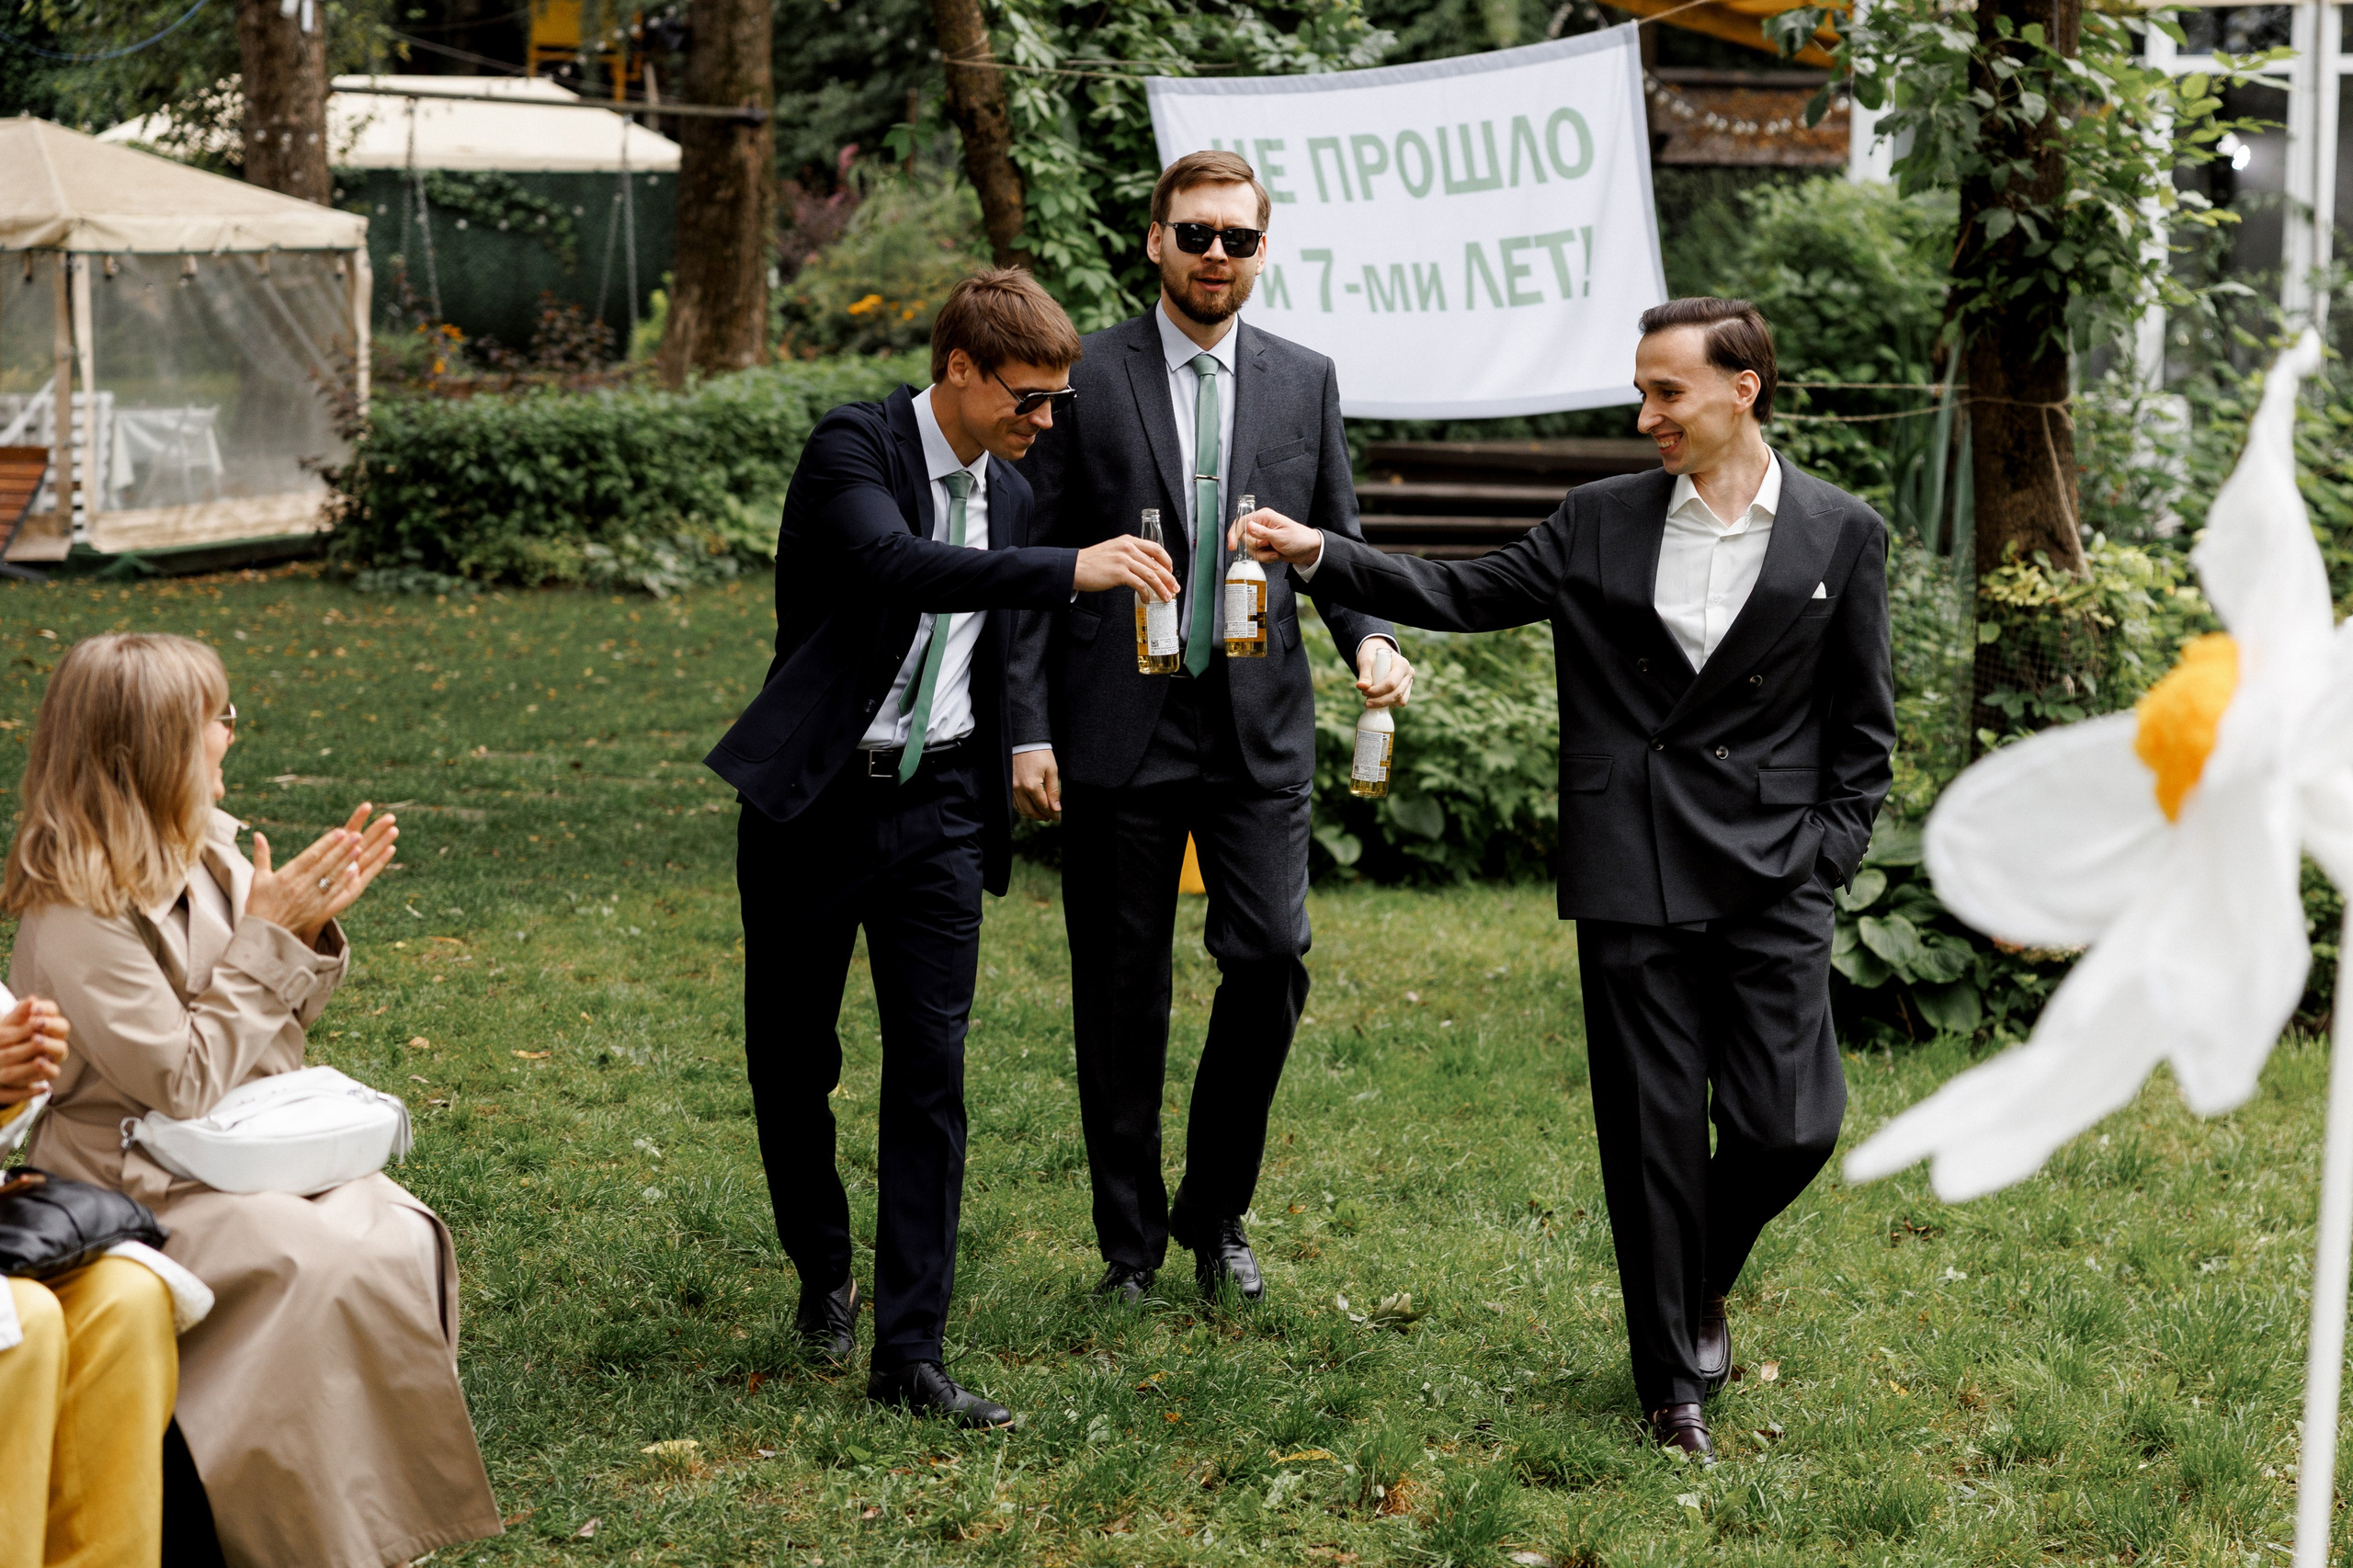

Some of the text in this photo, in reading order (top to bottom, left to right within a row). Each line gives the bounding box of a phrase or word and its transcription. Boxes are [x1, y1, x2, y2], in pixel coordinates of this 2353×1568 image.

[1211, 108, 1594, 204] Е ПРОШЛО
[1465, 226, 1592, 311] ЛЕТ!
